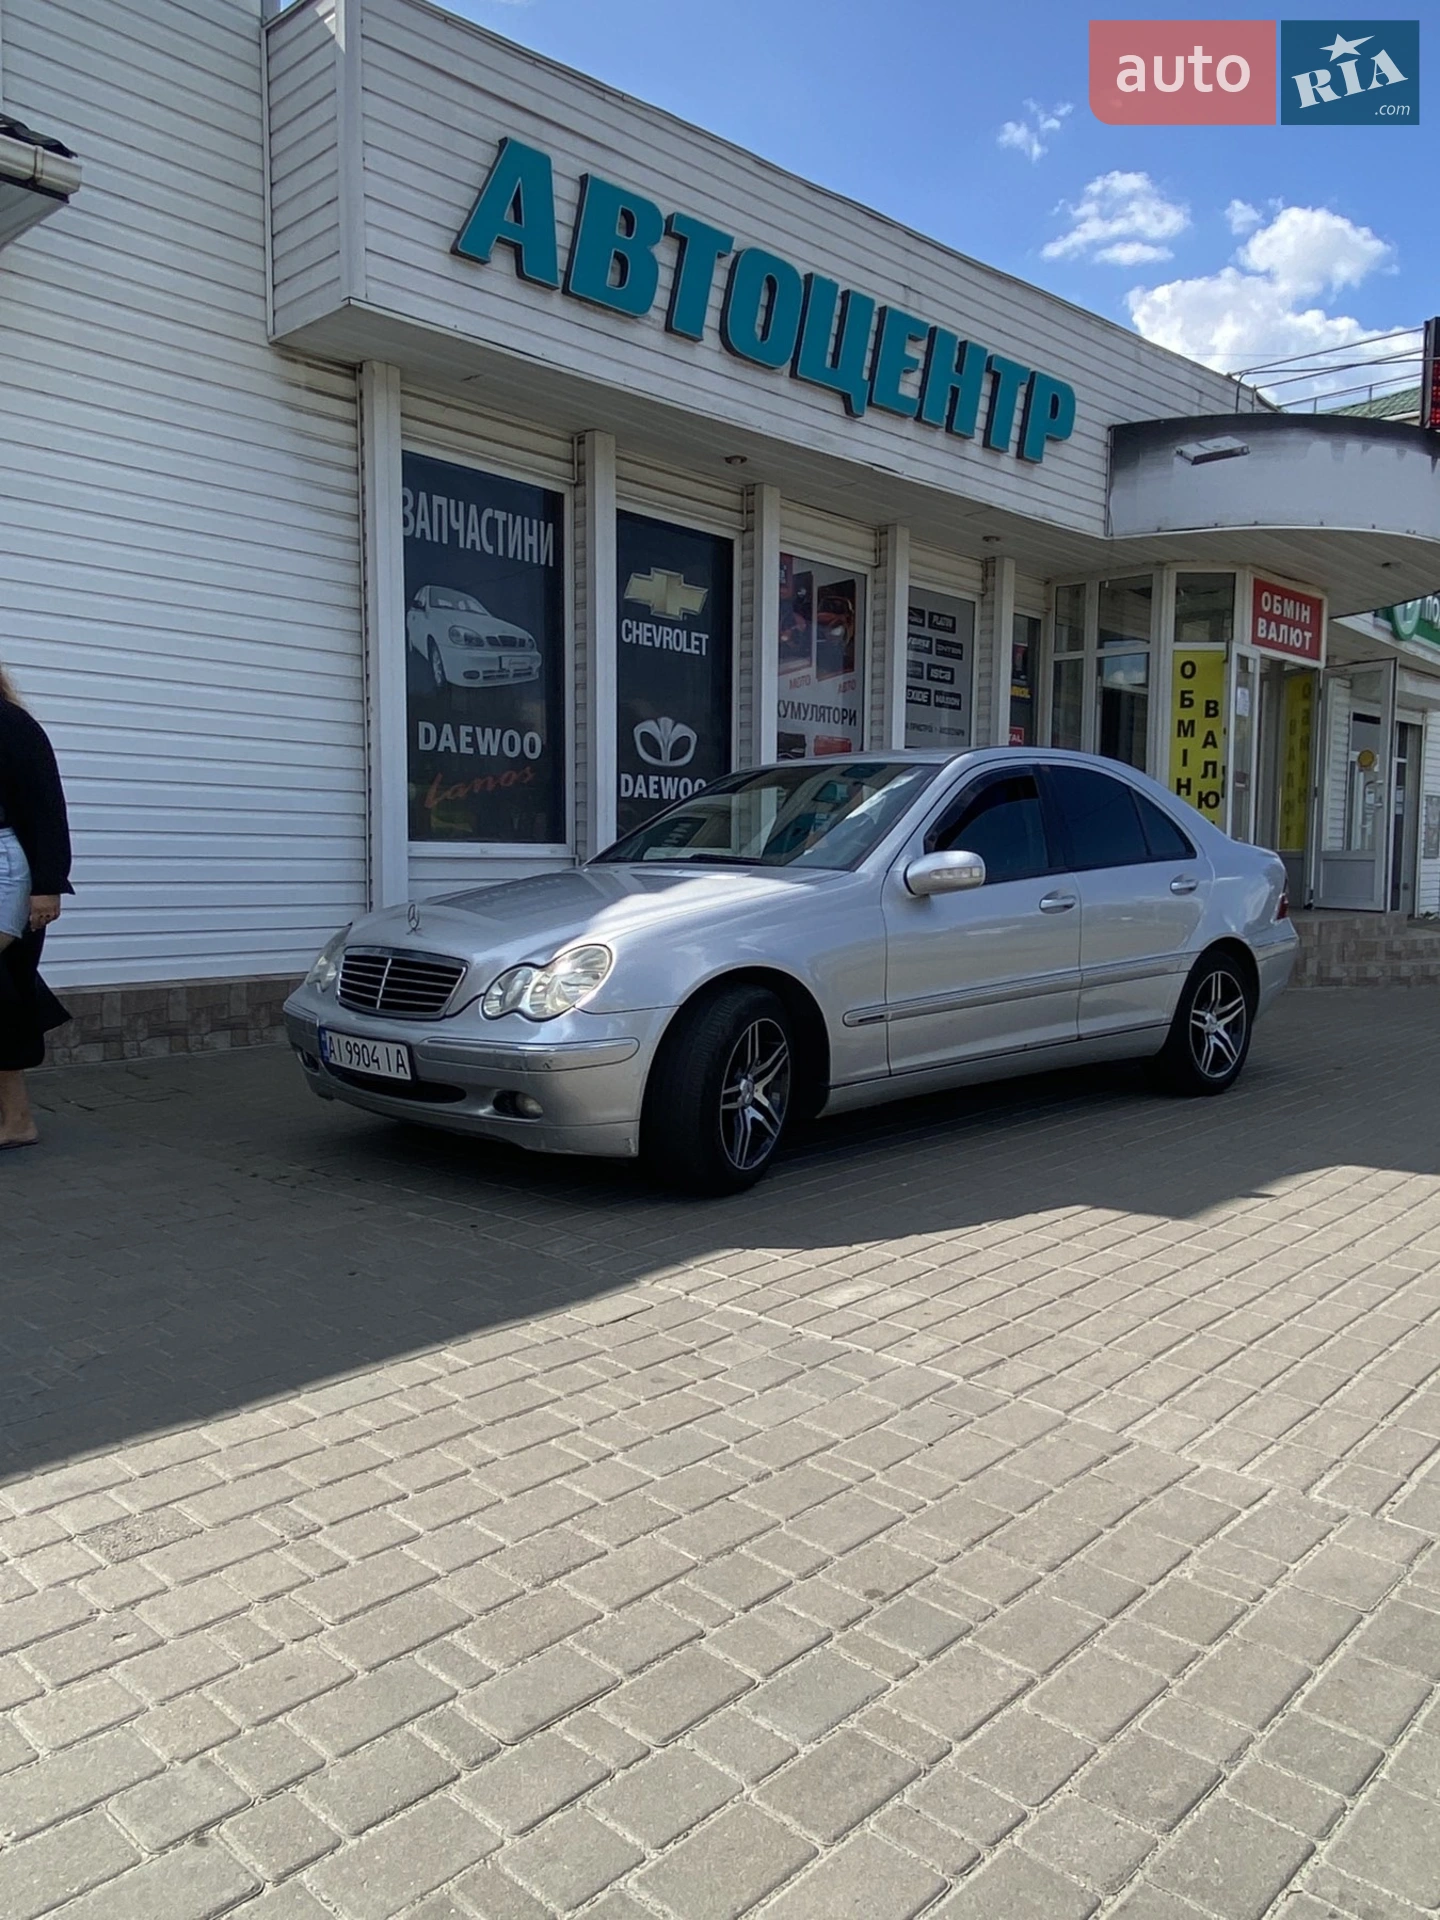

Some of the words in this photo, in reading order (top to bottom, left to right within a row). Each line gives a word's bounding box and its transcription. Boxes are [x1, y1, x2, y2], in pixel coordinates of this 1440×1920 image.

[450, 136, 1076, 464] АВТОЦЕНТР
[402, 487, 554, 567] ЗАПЧАСТИНИ
[1261, 591, 1311, 625] ОБМІН
[621, 618, 709, 656] CHEVROLET
[1257, 617, 1313, 651] ВАЛЮТ
[789, 675, 811, 691] МОТО
[838, 678, 857, 694] АВТО
[778, 699, 858, 727] КУМУЛЯТОРИ
[1176, 660, 1197, 797] ОБМІН
[418, 721, 542, 760] DAEWOO
[1009, 731, 1023, 743] TAL
[1197, 700, 1221, 825] ВАЛЮ
[328, 1036, 343, 1062] AI
[345, 1041, 381, 1071] 9904
[386, 1047, 408, 1075] IA
